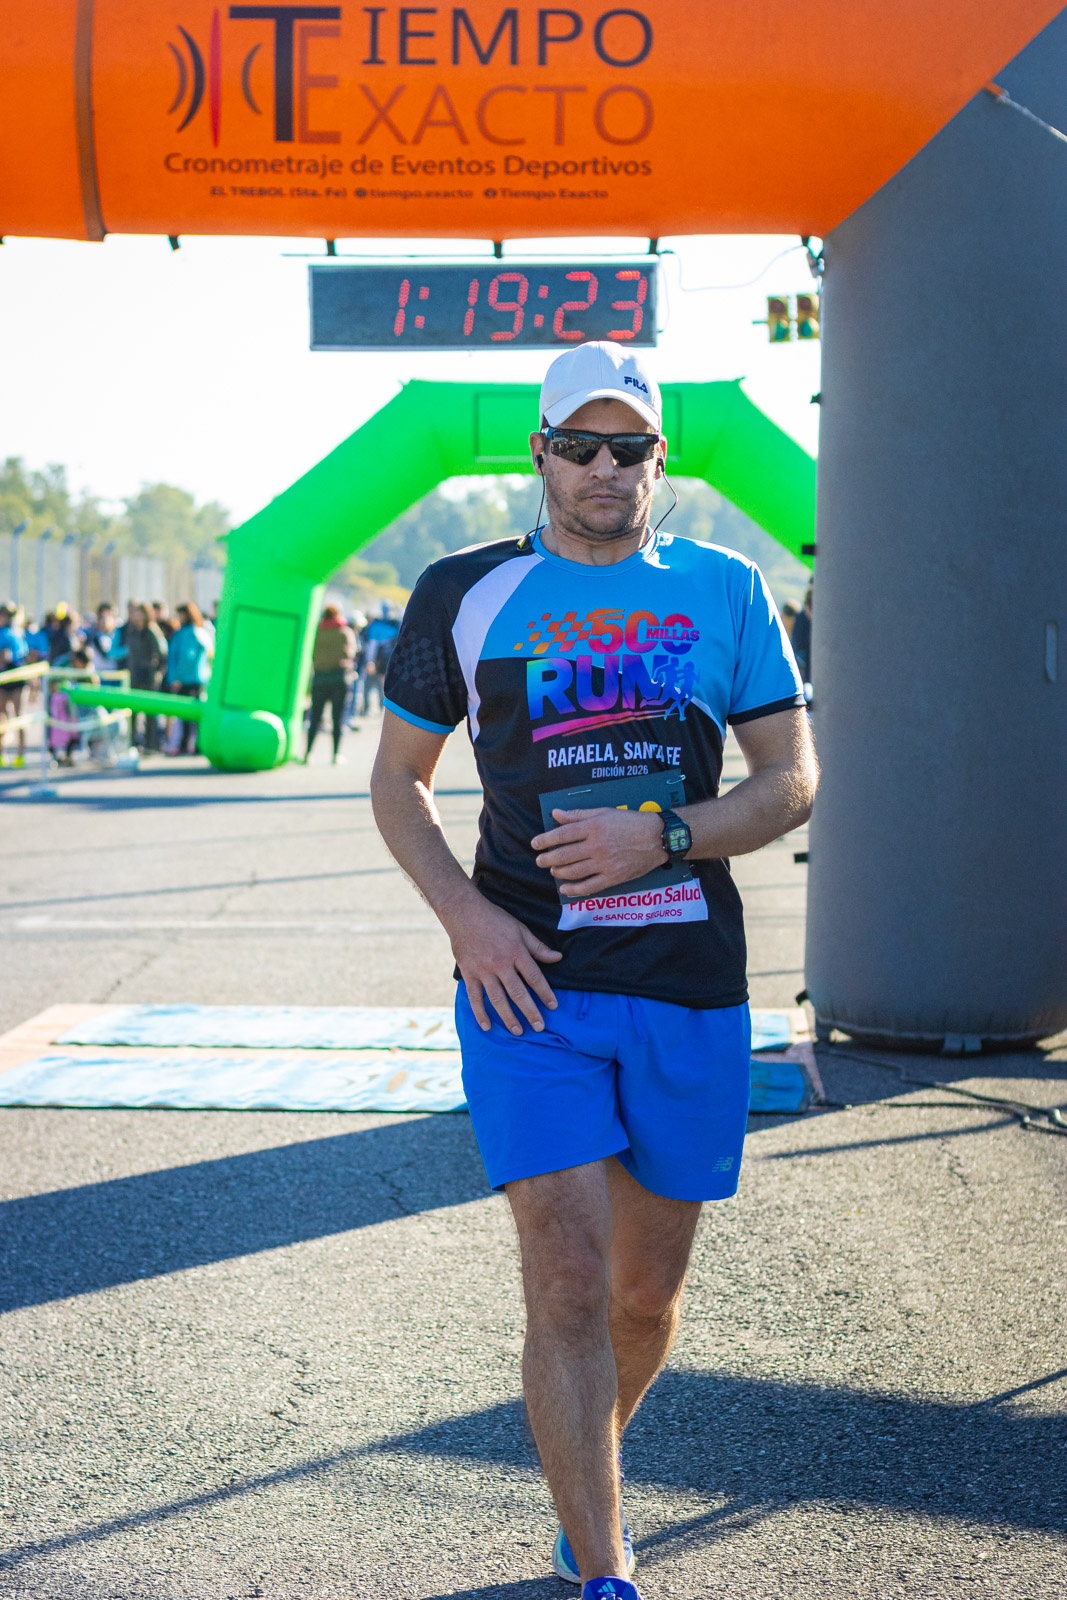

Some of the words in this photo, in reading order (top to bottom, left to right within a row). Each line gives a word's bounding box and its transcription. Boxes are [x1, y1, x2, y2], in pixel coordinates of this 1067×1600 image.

[164, 152, 343, 178] Cronometraje
[351, 154, 383, 175] de
[391, 154, 496, 175] Eventos
[504, 154, 652, 179] Deportivos
[210, 186, 227, 196] EL
[624, 376, 649, 394] FILA
[646, 627, 700, 642] MILLAS
[526, 654, 690, 720] RUN
[548, 743, 619, 769] RAFAELA,
[666, 746, 682, 766] FE
[591, 765, 625, 779] EDICIÓN
[627, 764, 649, 776] 2026
[664, 885, 701, 903] Salud
[593, 914, 603, 922] de
[605, 912, 643, 921] SANCOR
[646, 908, 683, 920] SEGUROS
